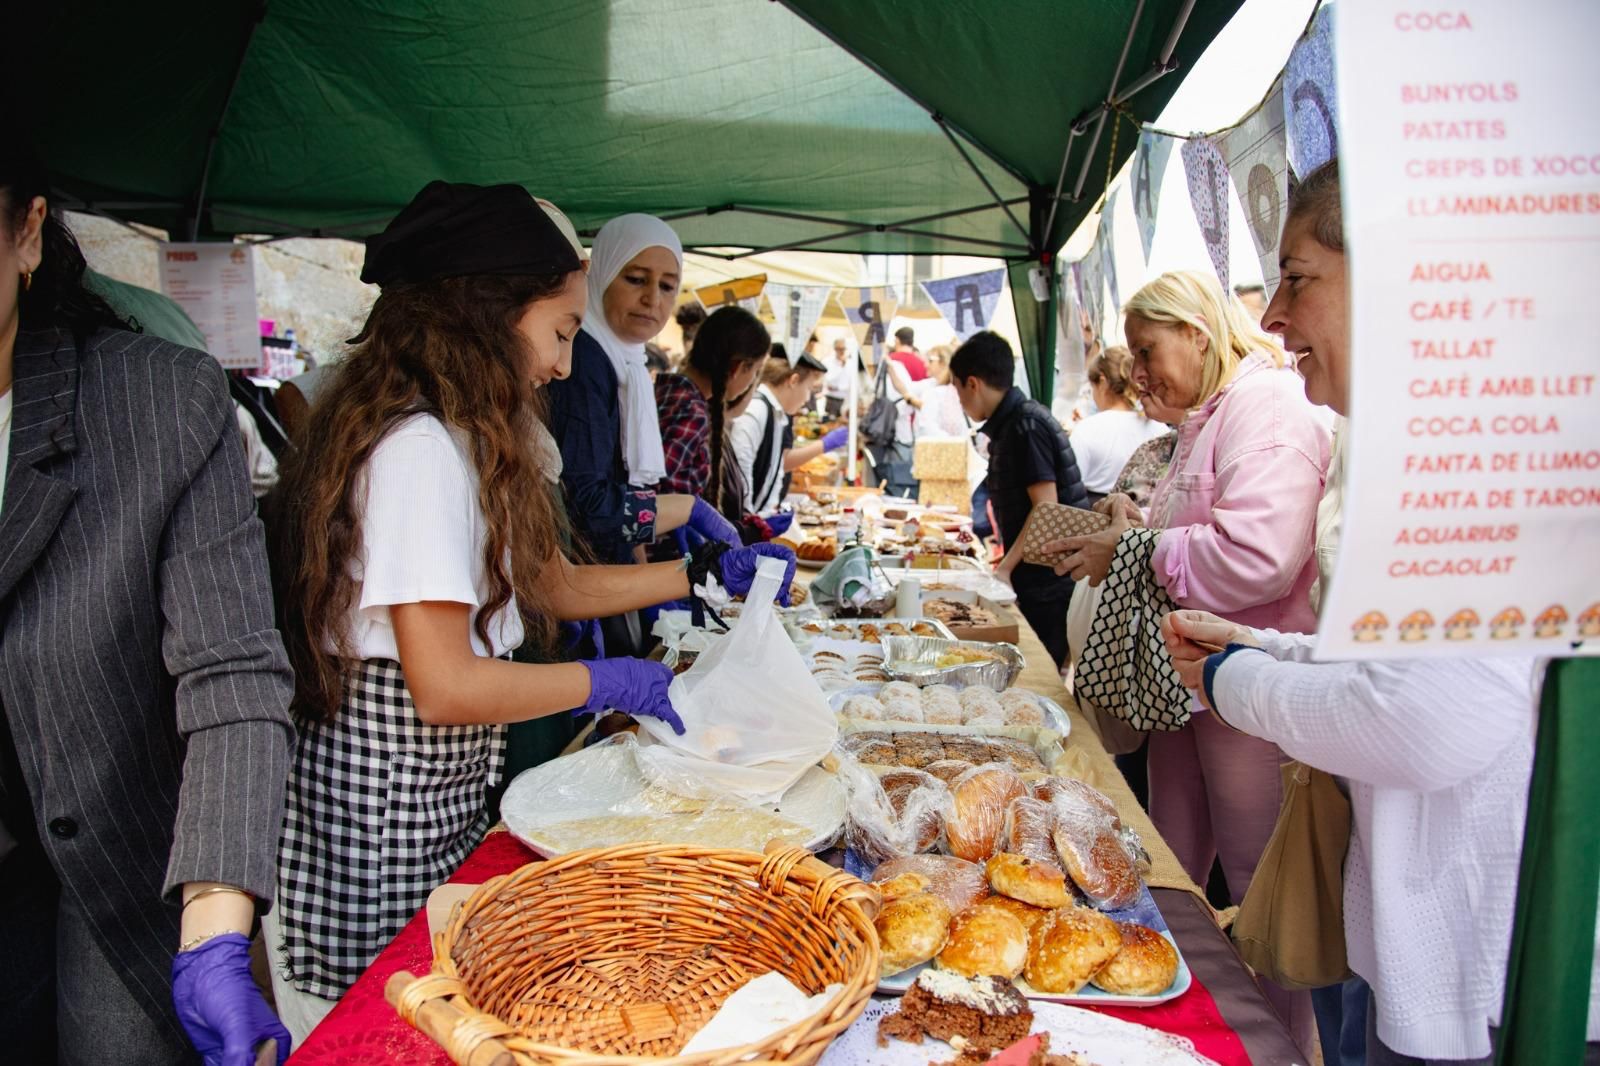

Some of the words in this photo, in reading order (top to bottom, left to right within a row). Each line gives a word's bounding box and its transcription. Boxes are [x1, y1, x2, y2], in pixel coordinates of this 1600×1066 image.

[1395, 11, 1472, 31] COCA
[1400, 82, 1519, 104] BUNYOLS
[1402, 119, 1506, 140] PATATES
[1406, 158, 1485, 178] CREPS
[1493, 157, 1522, 176] DE
[1408, 193, 1600, 216] LLAMINADURES
[1409, 262, 1492, 282] AIGUA
[1483, 302, 1497, 318] /
[1505, 298, 1535, 319] TE
[1409, 338, 1496, 360] TALLAT
[1479, 375, 1535, 398] AMB
[1542, 374, 1596, 397] LLET
[1406, 416, 1483, 437] COCA
[1490, 415, 1560, 435] COLA
[1403, 453, 1483, 475] FANTA
[1491, 452, 1520, 472] DE
[1527, 449, 1600, 472] LLIMO
[1400, 490, 1478, 511] FANTA
[1486, 488, 1515, 509] DE
[1394, 523, 1520, 546] AQUARIUS
[1387, 556, 1516, 579] CACAOLAT
